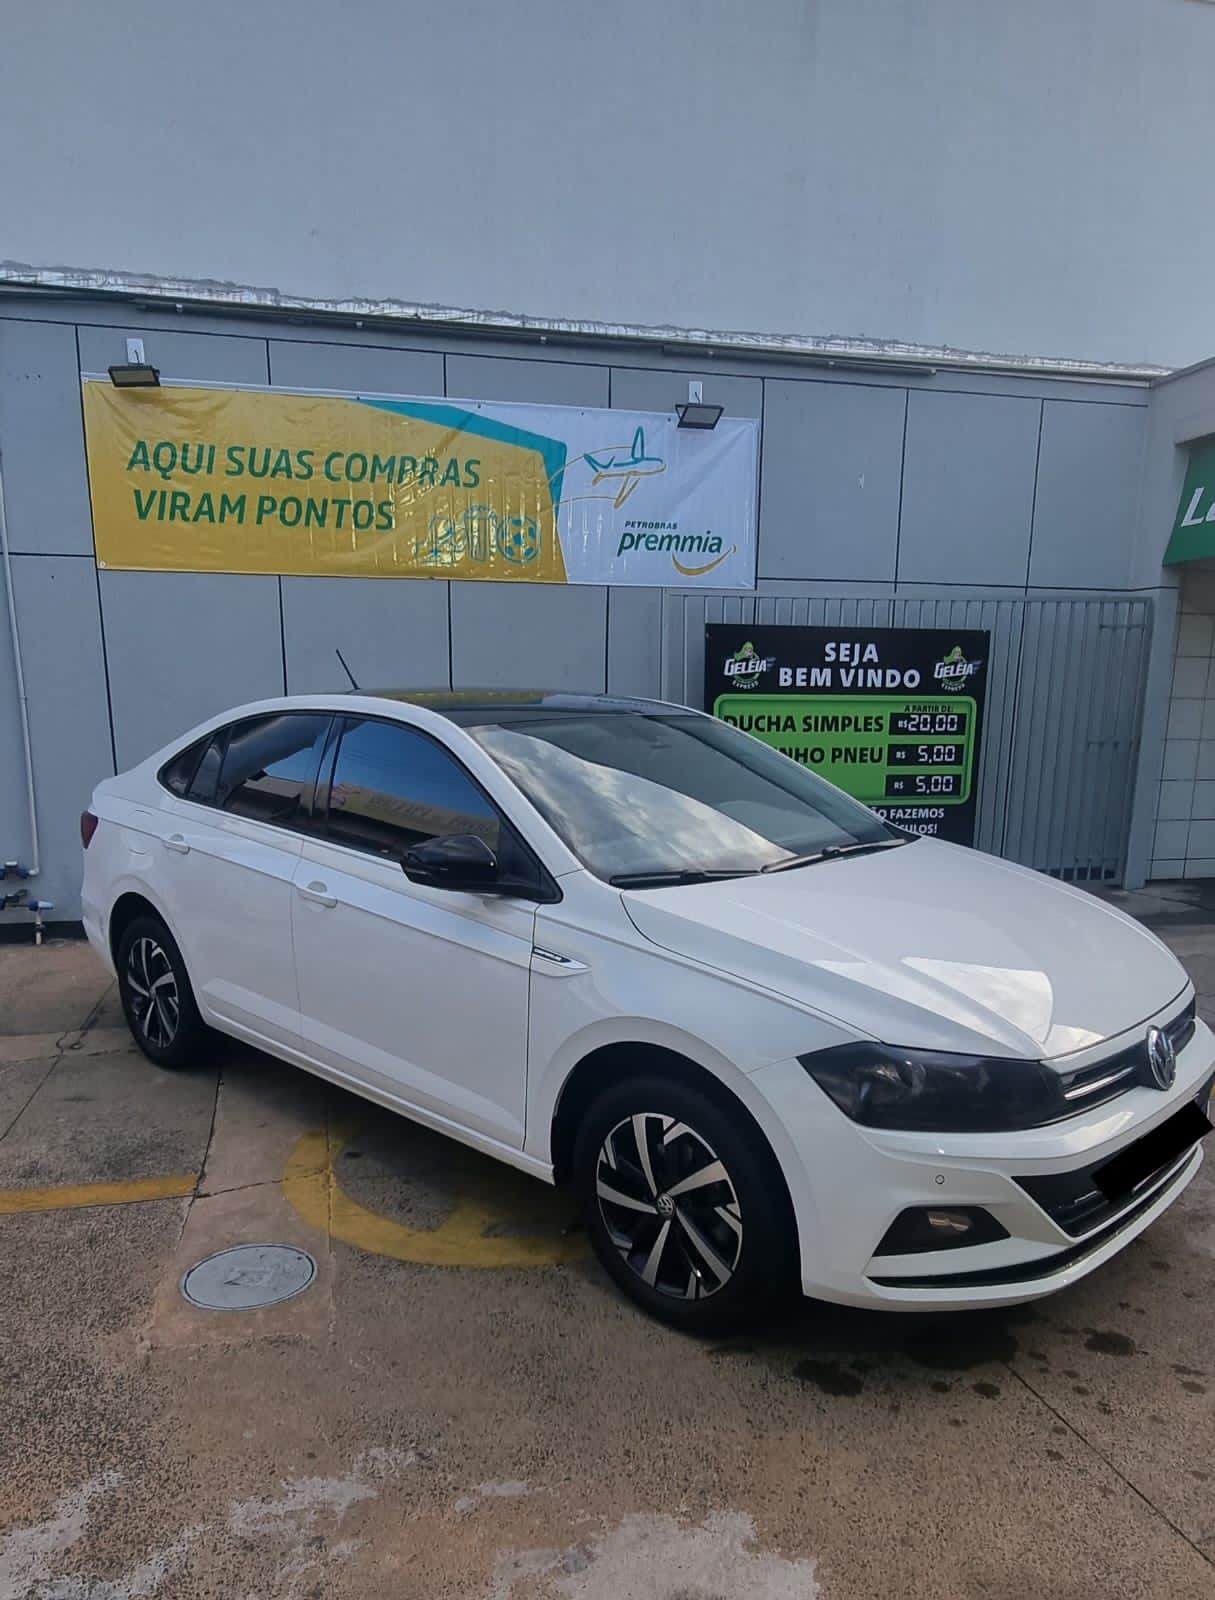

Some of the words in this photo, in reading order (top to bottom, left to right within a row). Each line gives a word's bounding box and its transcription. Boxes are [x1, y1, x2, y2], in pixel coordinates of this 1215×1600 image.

[126, 440, 216, 480] AQUI
[225, 446, 314, 480] SUAS
[323, 452, 481, 488] COMPRAS
[134, 489, 247, 524] VIRAM
[256, 495, 394, 530] PONTOS
[624, 520, 678, 530] PETROBRAS
[617, 530, 723, 557] premmia
[824, 642, 879, 667] SEJA
[779, 667, 832, 687] BEM
[840, 668, 921, 688] VINDO
[912, 704, 940, 713] PARTIR
[723, 715, 796, 732] DUCHA
[802, 715, 884, 732] SIMPLES
[908, 714, 958, 734] 20,00
[831, 747, 883, 764] PNEU
[918, 745, 956, 764] 5,00
[915, 775, 953, 794] 5,00
[889, 808, 945, 819] FAZEMOS
